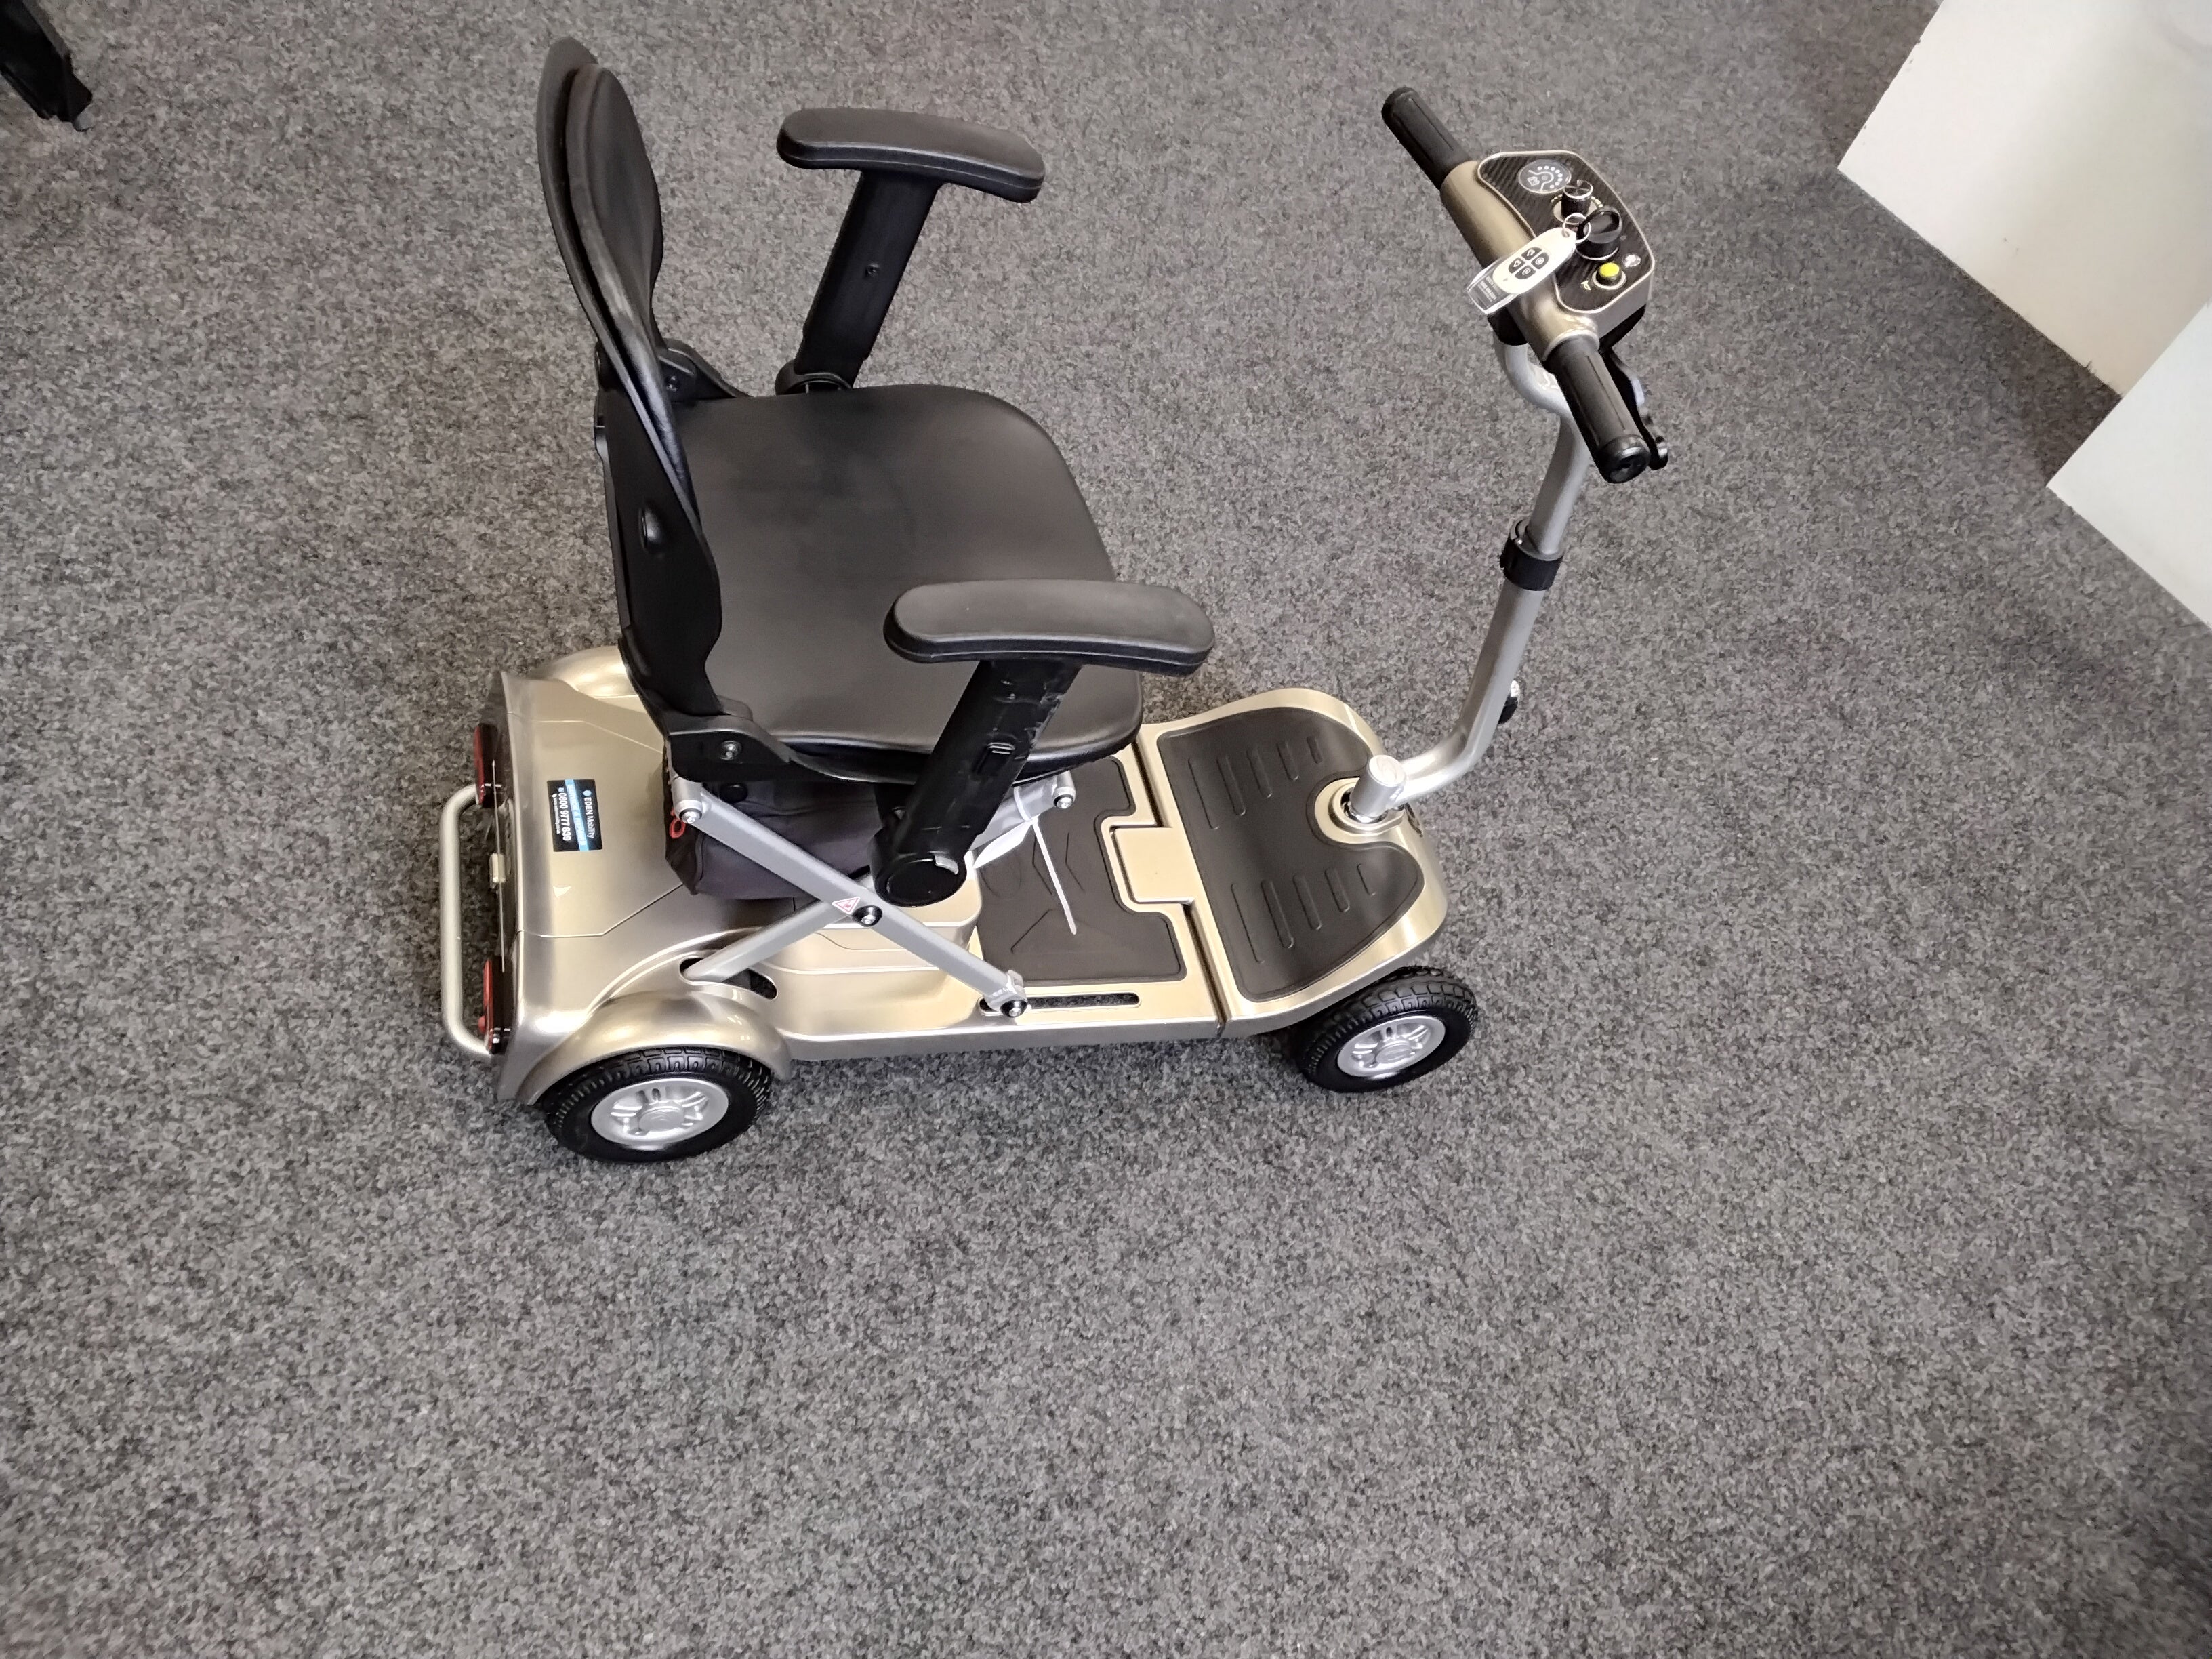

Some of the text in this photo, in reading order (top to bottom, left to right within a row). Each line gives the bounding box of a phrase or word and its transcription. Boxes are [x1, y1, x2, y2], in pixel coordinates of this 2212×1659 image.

[558, 792, 571, 841] 0800 9777 839
[584, 797, 596, 838] EDEN Mobility
